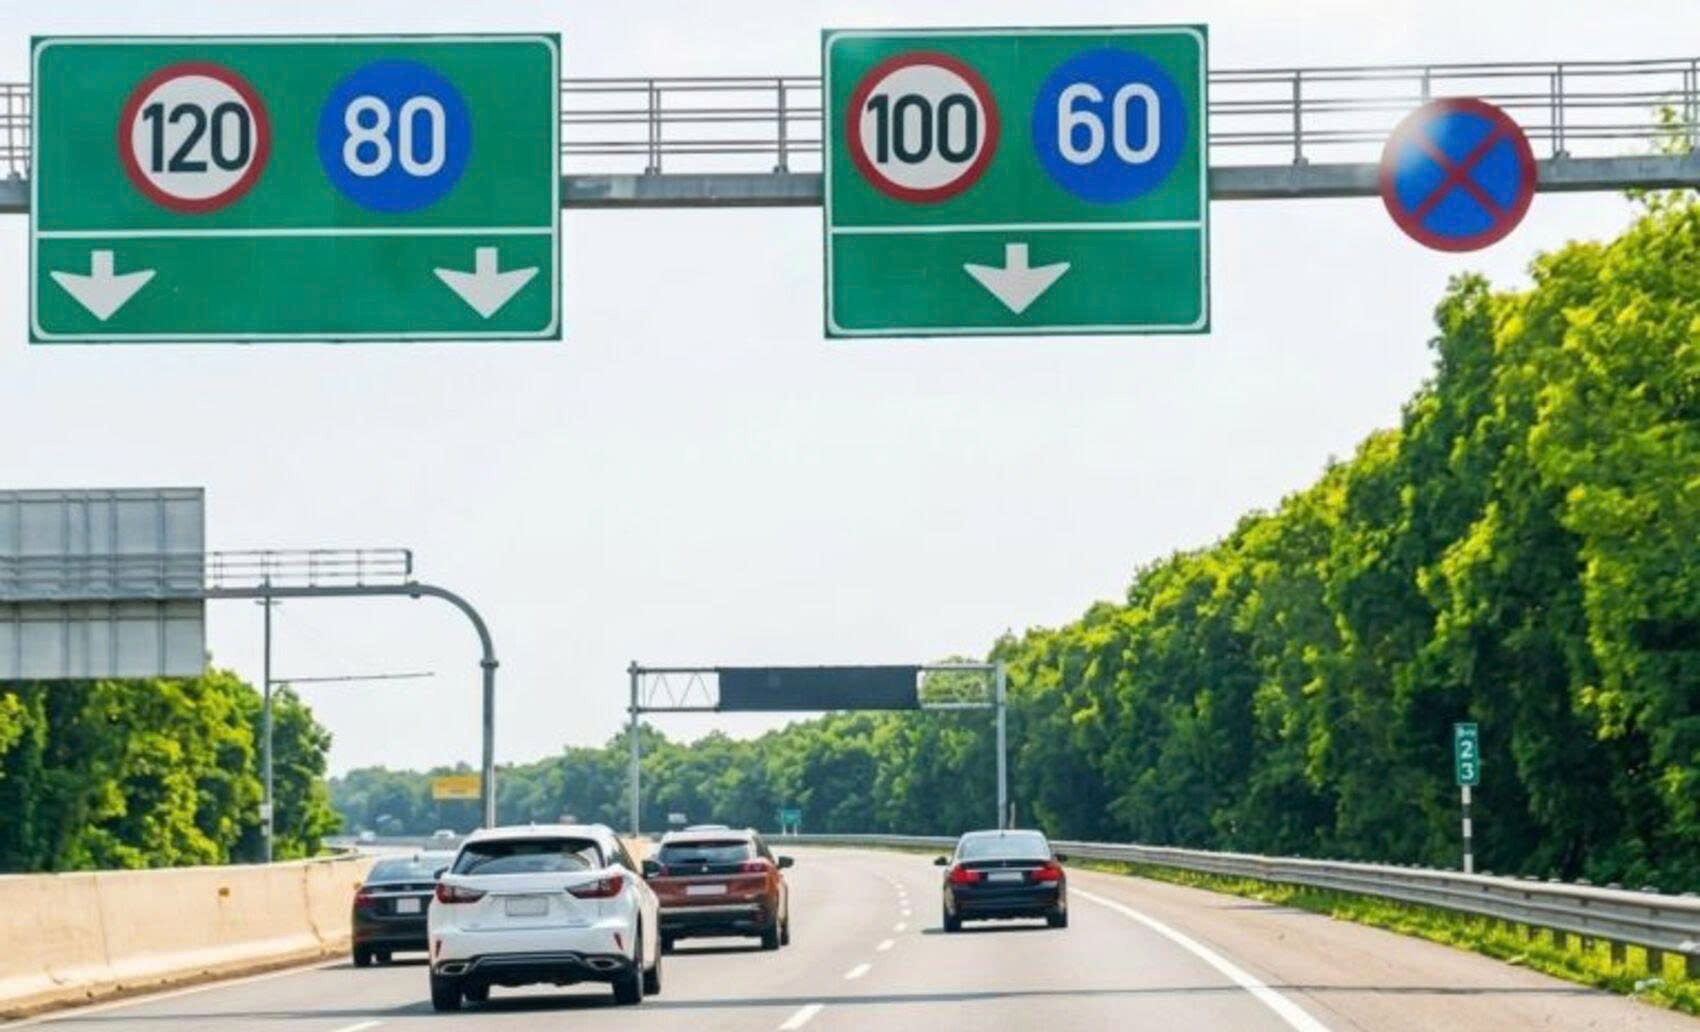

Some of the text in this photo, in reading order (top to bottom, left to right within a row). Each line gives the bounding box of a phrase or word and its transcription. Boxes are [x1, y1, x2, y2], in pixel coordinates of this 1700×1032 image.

[142, 100, 251, 174] 120
[343, 96, 446, 176] 80
[866, 92, 978, 165] 100
[1057, 82, 1160, 164] 60
